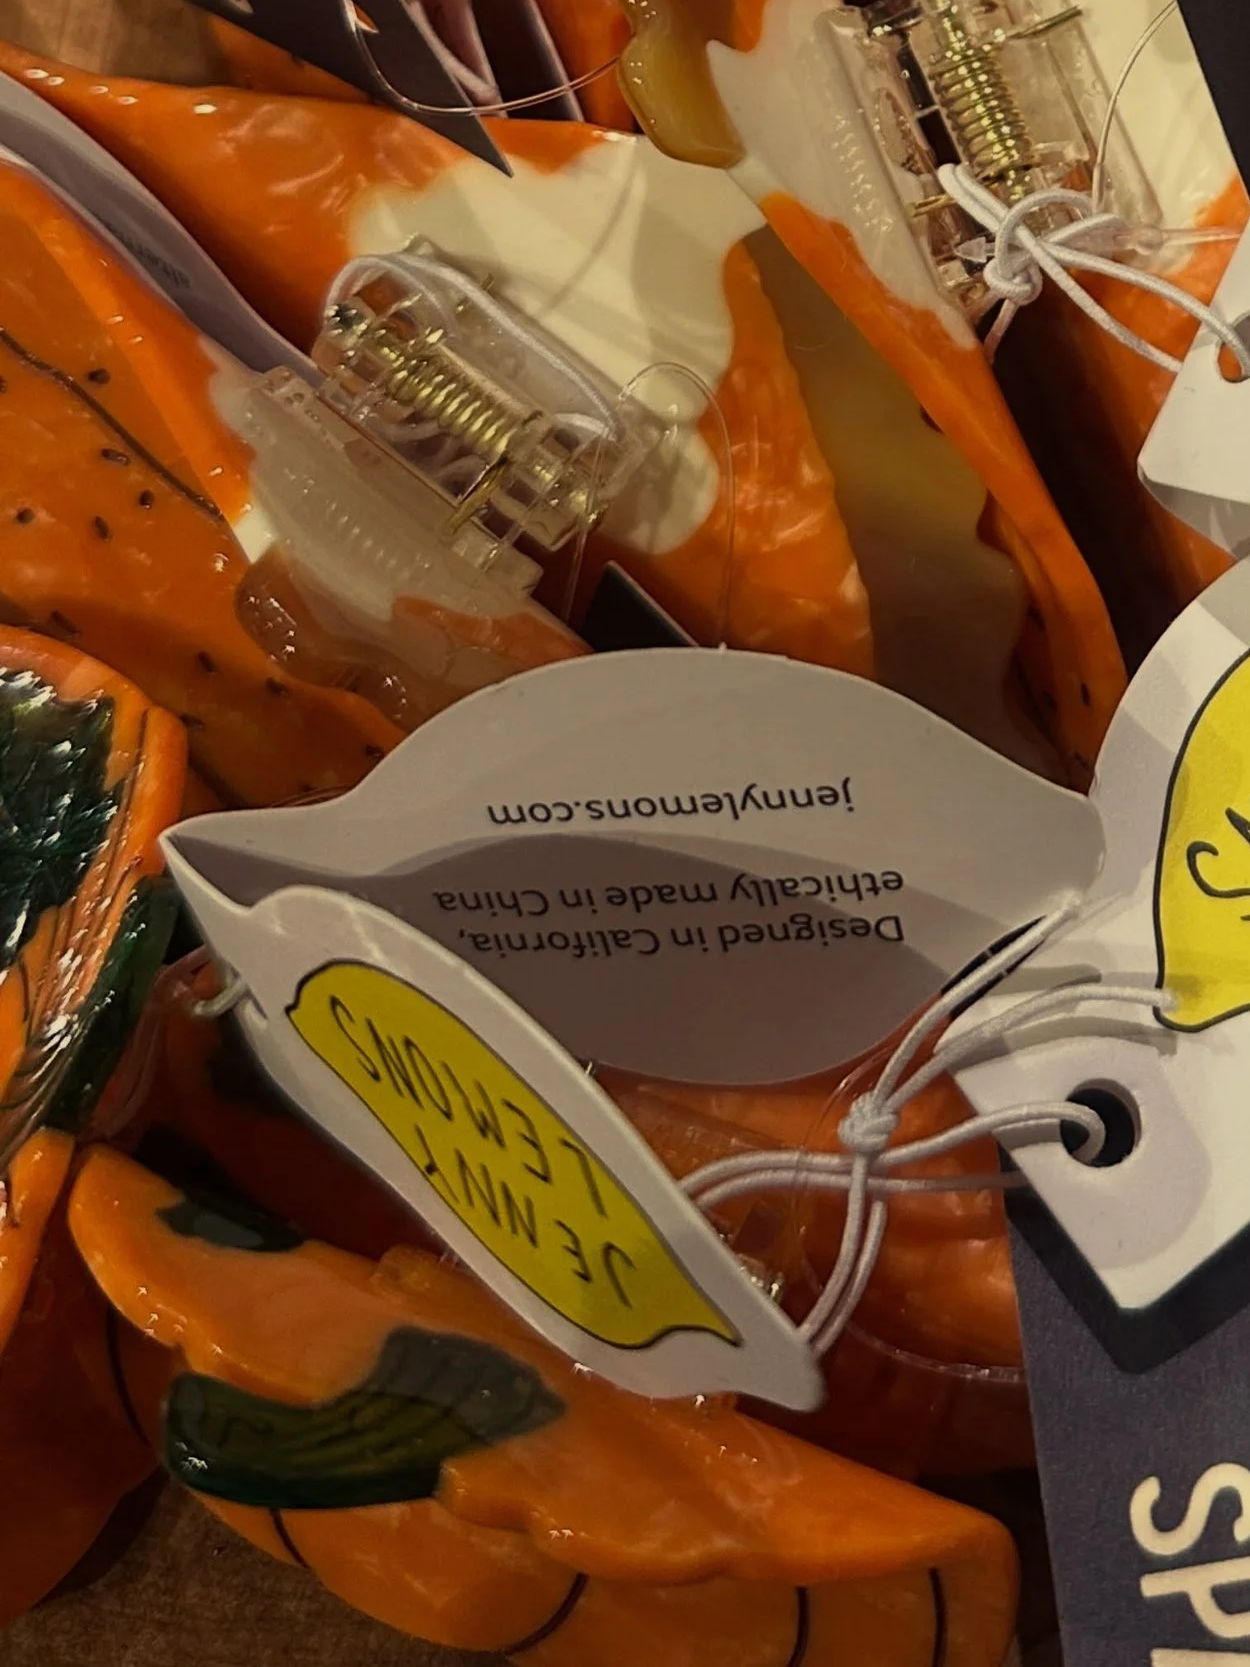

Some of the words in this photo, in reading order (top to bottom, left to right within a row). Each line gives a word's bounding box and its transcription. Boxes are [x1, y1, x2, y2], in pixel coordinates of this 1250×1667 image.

[486, 776, 856, 826] jennylemons.com
[432, 887, 550, 918] China
[559, 887, 599, 916] in
[605, 881, 719, 914] made
[729, 869, 906, 903] ethically
[458, 927, 661, 959] California,
[669, 926, 710, 955] in
[717, 912, 906, 947] Designed
[329, 995, 608, 1220] LEMONS
[414, 1122, 637, 1309] JENNY
